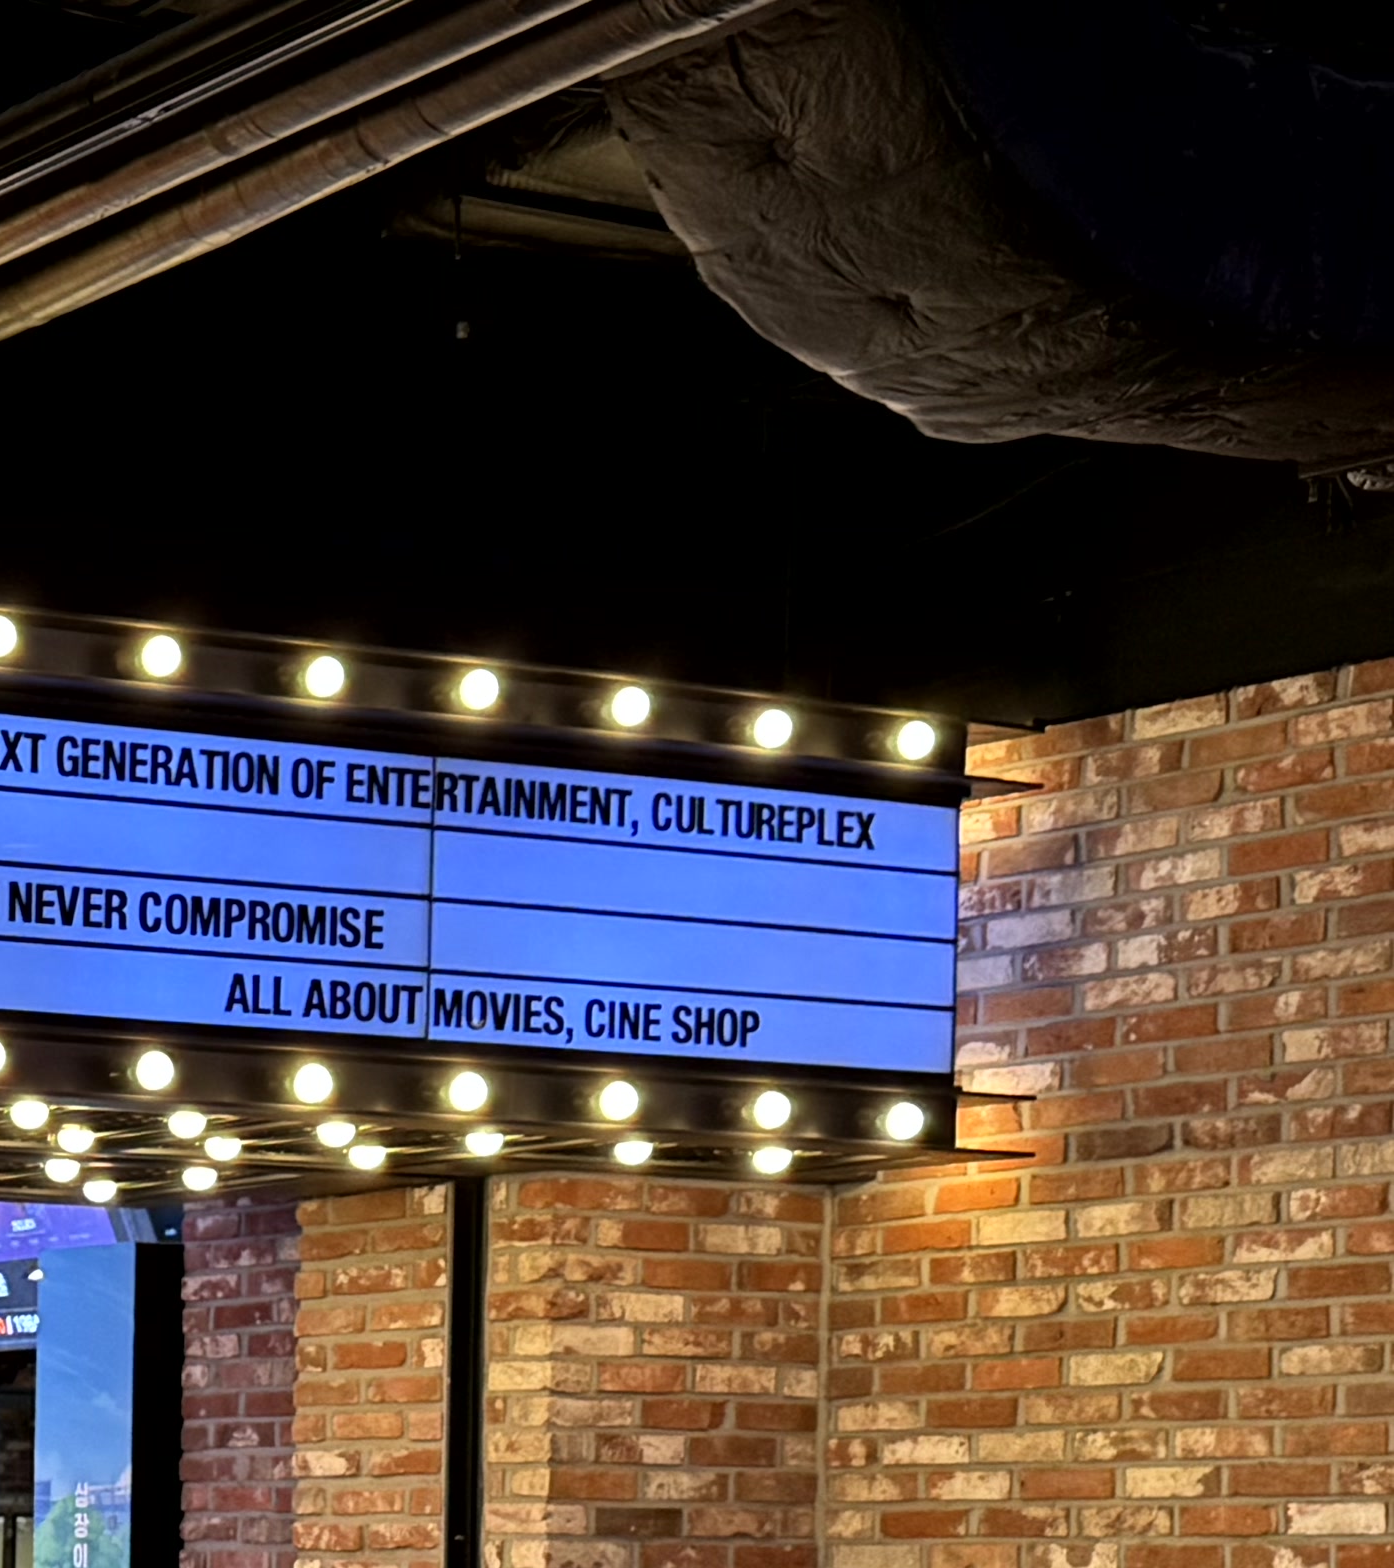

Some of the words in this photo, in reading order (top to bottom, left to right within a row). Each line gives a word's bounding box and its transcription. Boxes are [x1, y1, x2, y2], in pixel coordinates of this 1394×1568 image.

[55, 735, 279, 799] GENERATION
[290, 756, 336, 801] OF
[346, 764, 640, 836] ENTERTAINMENT,
[650, 792, 876, 850] CULTUREPLEX
[8, 880, 128, 931] NEVER
[138, 892, 385, 949] COMPROMISE
[224, 972, 287, 1017] ALL
[303, 978, 423, 1025] ABOUT
[434, 988, 574, 1043] MOVIES,
[583, 998, 661, 1040] CINE
[672, 1003, 760, 1049] SHOP
